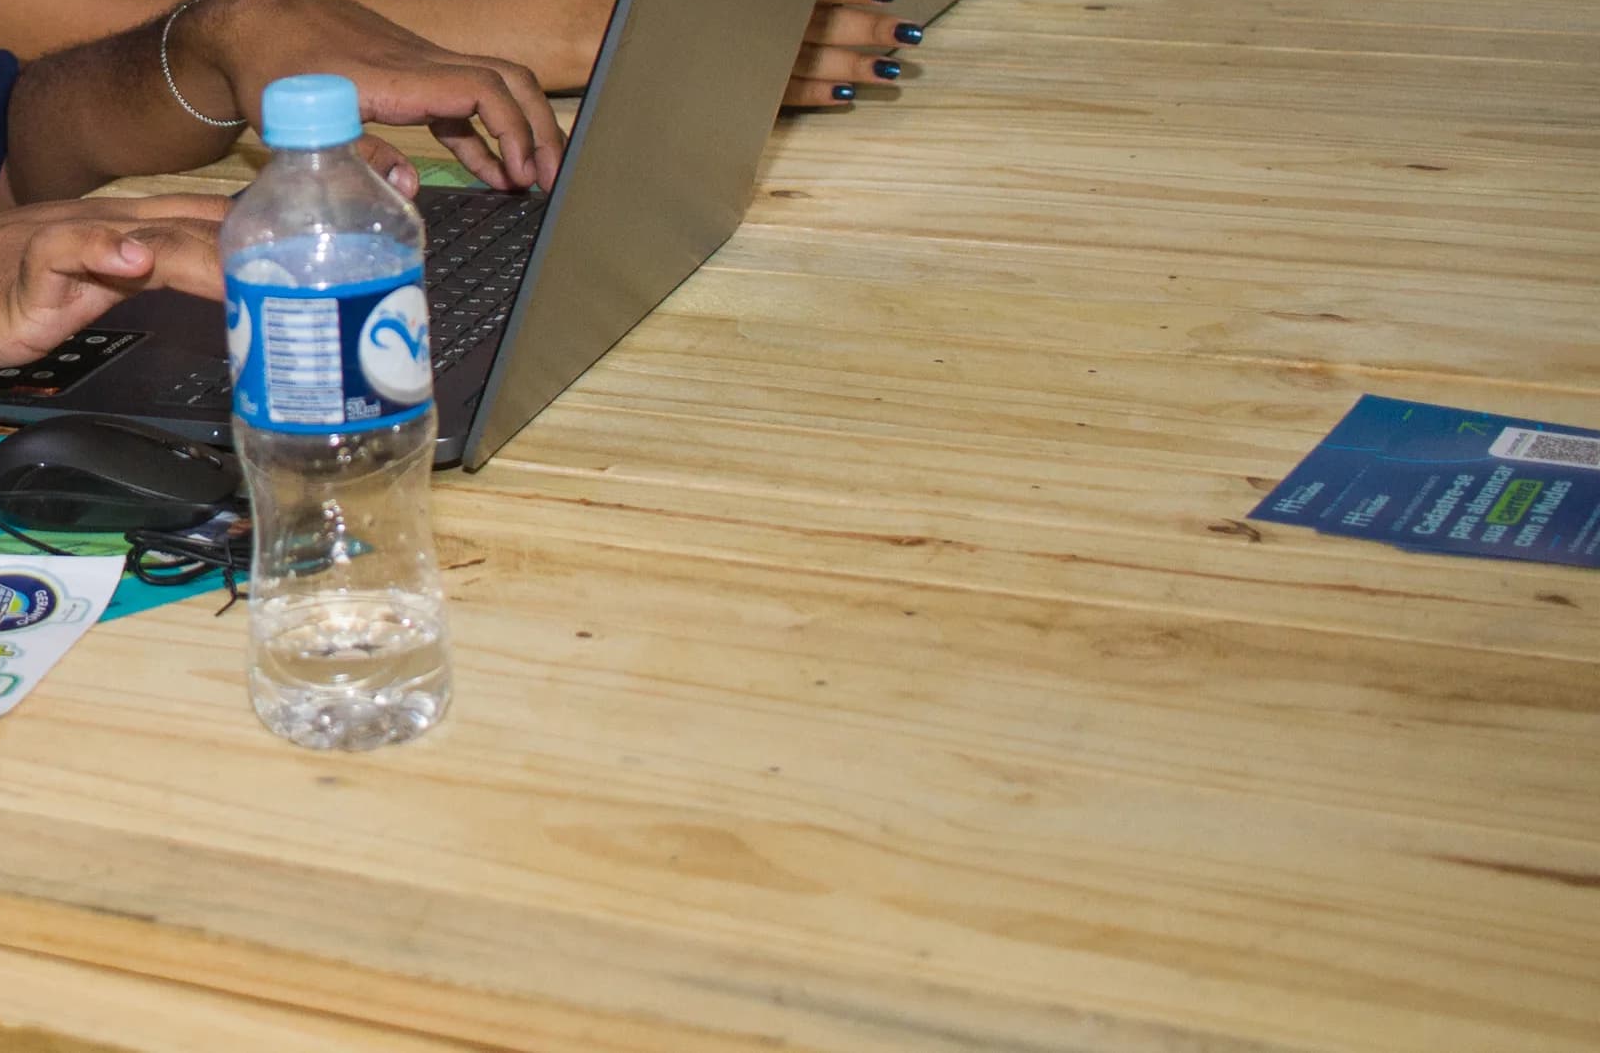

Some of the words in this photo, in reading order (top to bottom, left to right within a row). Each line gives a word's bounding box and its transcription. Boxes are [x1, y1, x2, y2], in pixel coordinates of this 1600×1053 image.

[1412, 474, 1476, 535] Cadastre-se
[1448, 512, 1480, 540] para
[1464, 465, 1515, 515] alavancar
[1480, 524, 1507, 543] sua
[1513, 523, 1543, 547] com
[1531, 480, 1573, 515] Mudes
